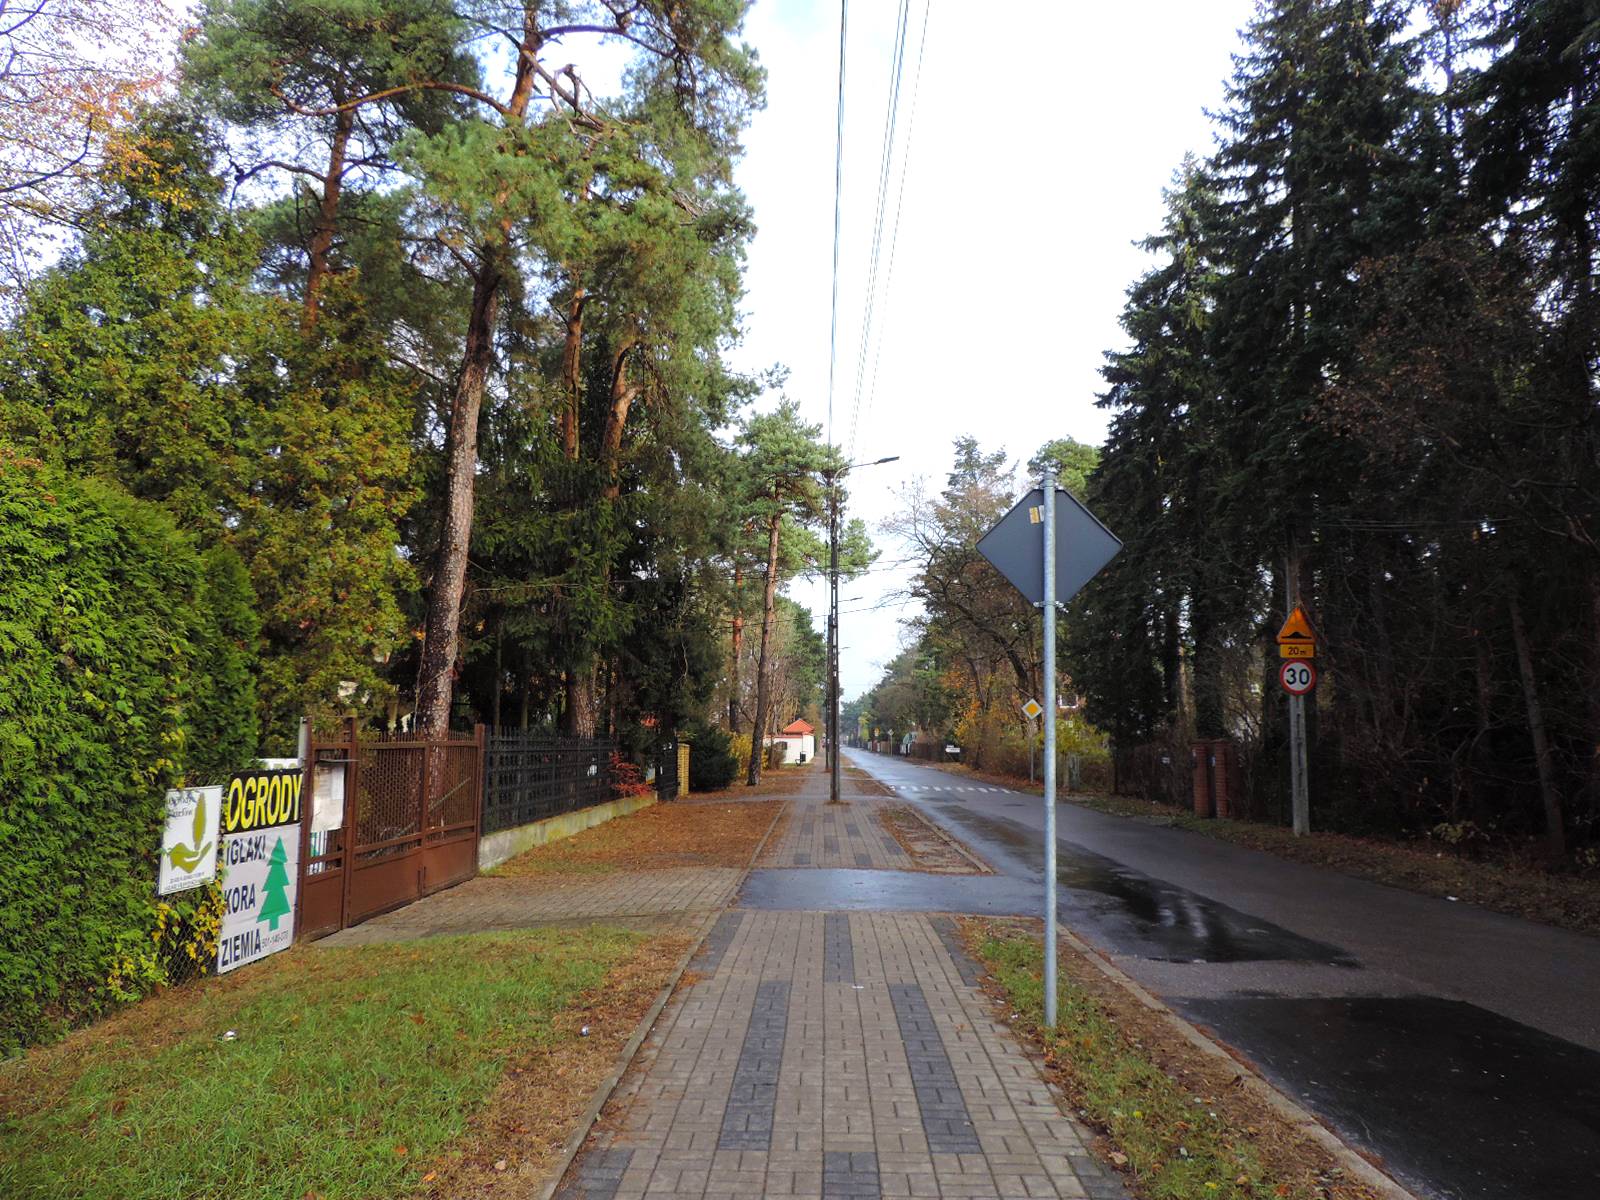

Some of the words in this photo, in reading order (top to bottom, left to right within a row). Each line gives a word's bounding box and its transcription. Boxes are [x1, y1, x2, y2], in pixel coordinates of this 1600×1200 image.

[1288, 647, 1299, 655] 20
[1286, 668, 1310, 685] 30
[226, 774, 303, 832] OGRODY
[226, 835, 266, 866] IGLAKI
[224, 883, 256, 915] KORA
[221, 929, 261, 966] ZIEMIA
